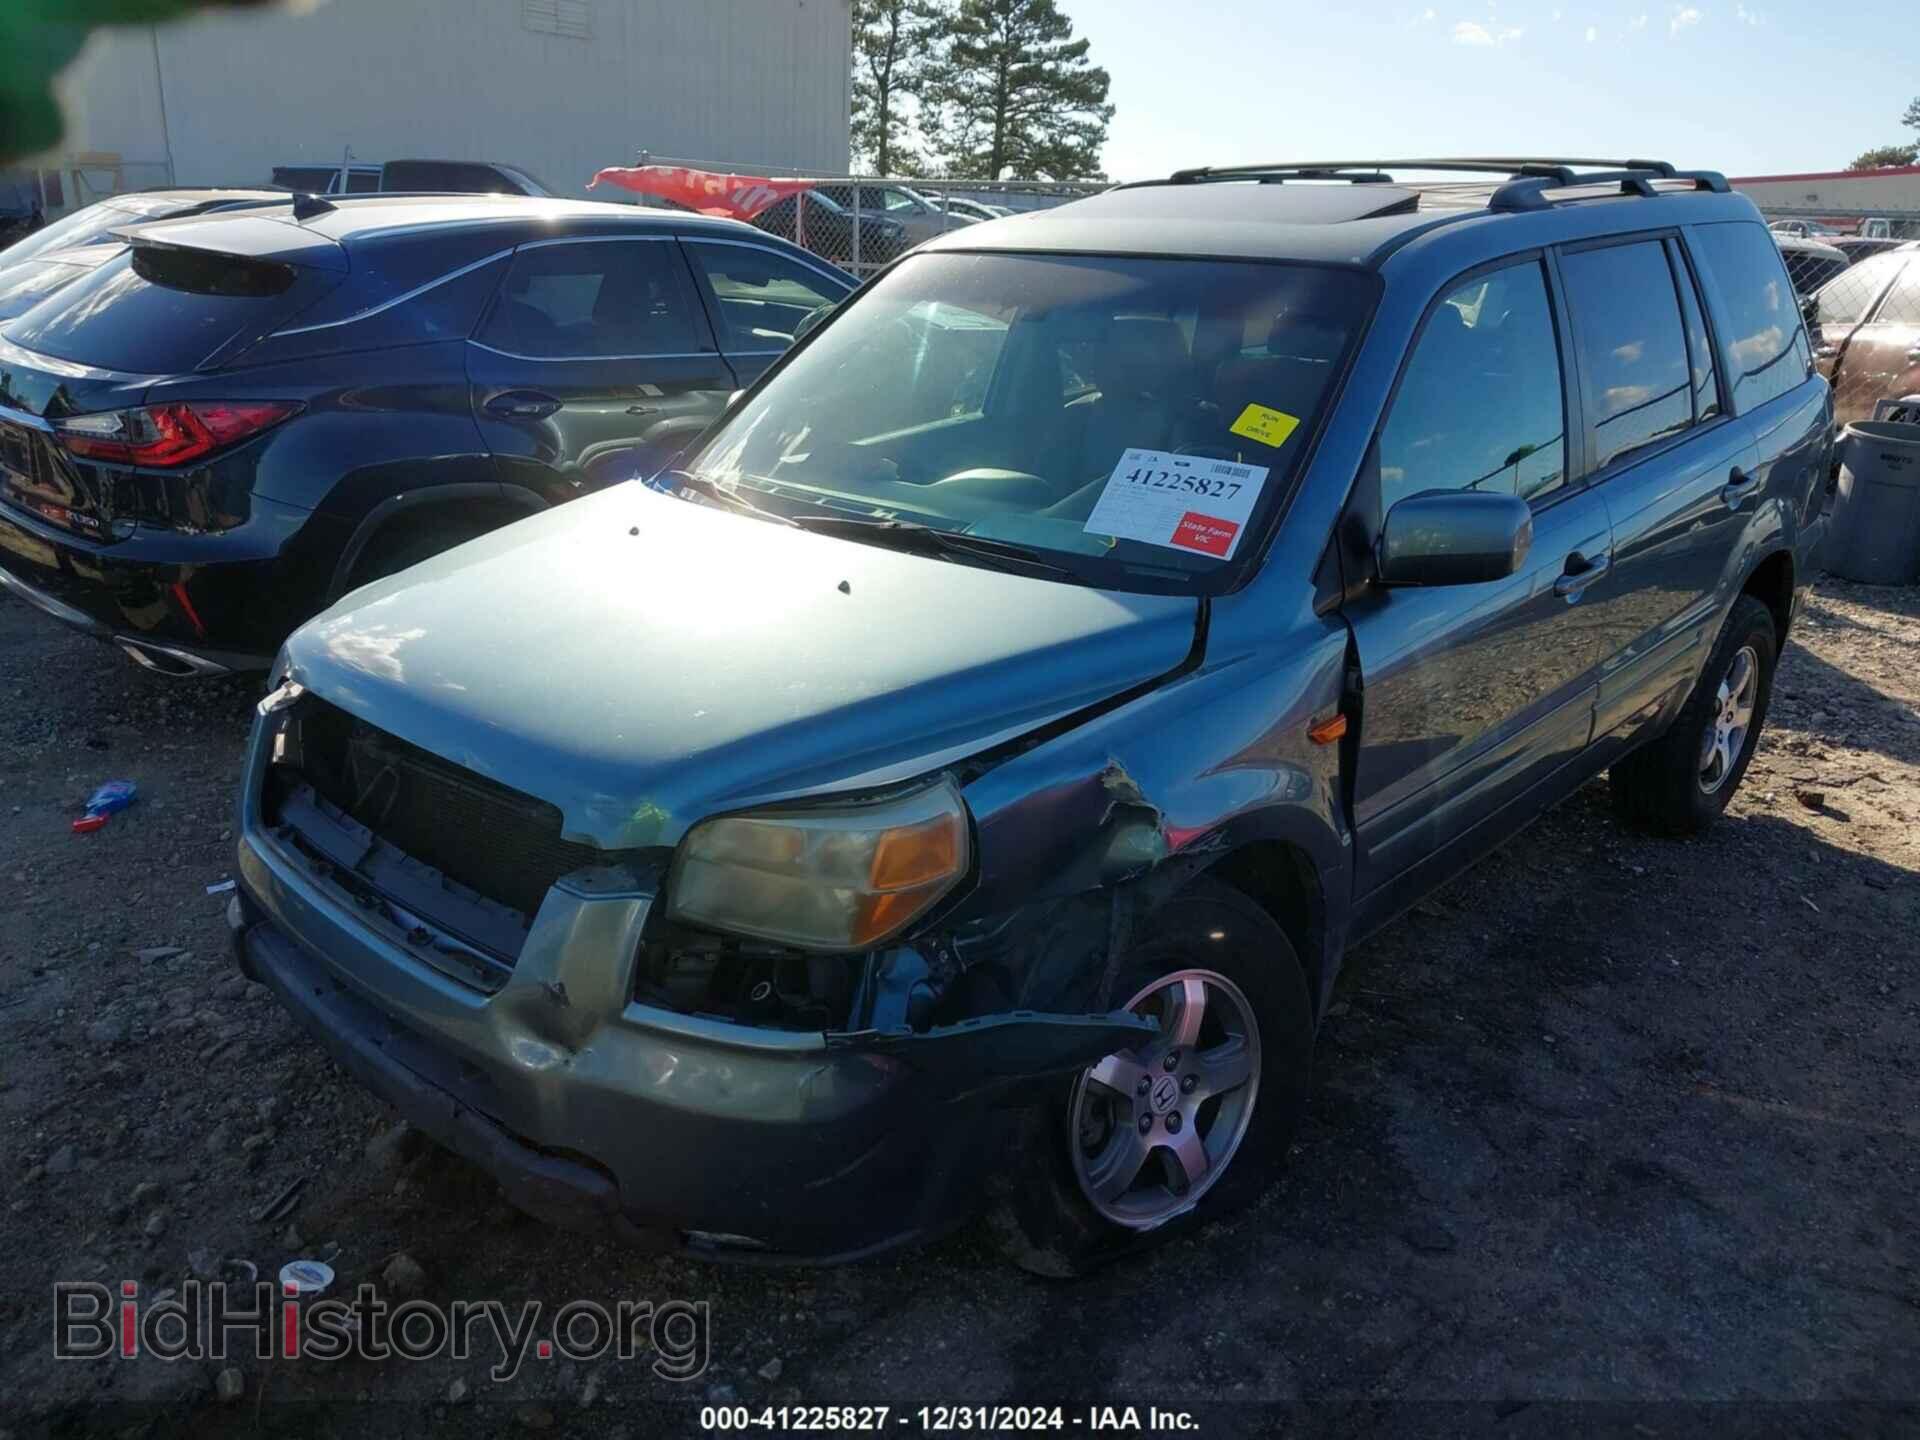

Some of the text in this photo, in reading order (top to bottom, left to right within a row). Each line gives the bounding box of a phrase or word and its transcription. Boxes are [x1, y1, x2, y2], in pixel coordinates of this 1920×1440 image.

[1126, 468, 1242, 500] 41225827
[1181, 520, 1233, 539] State Farm
